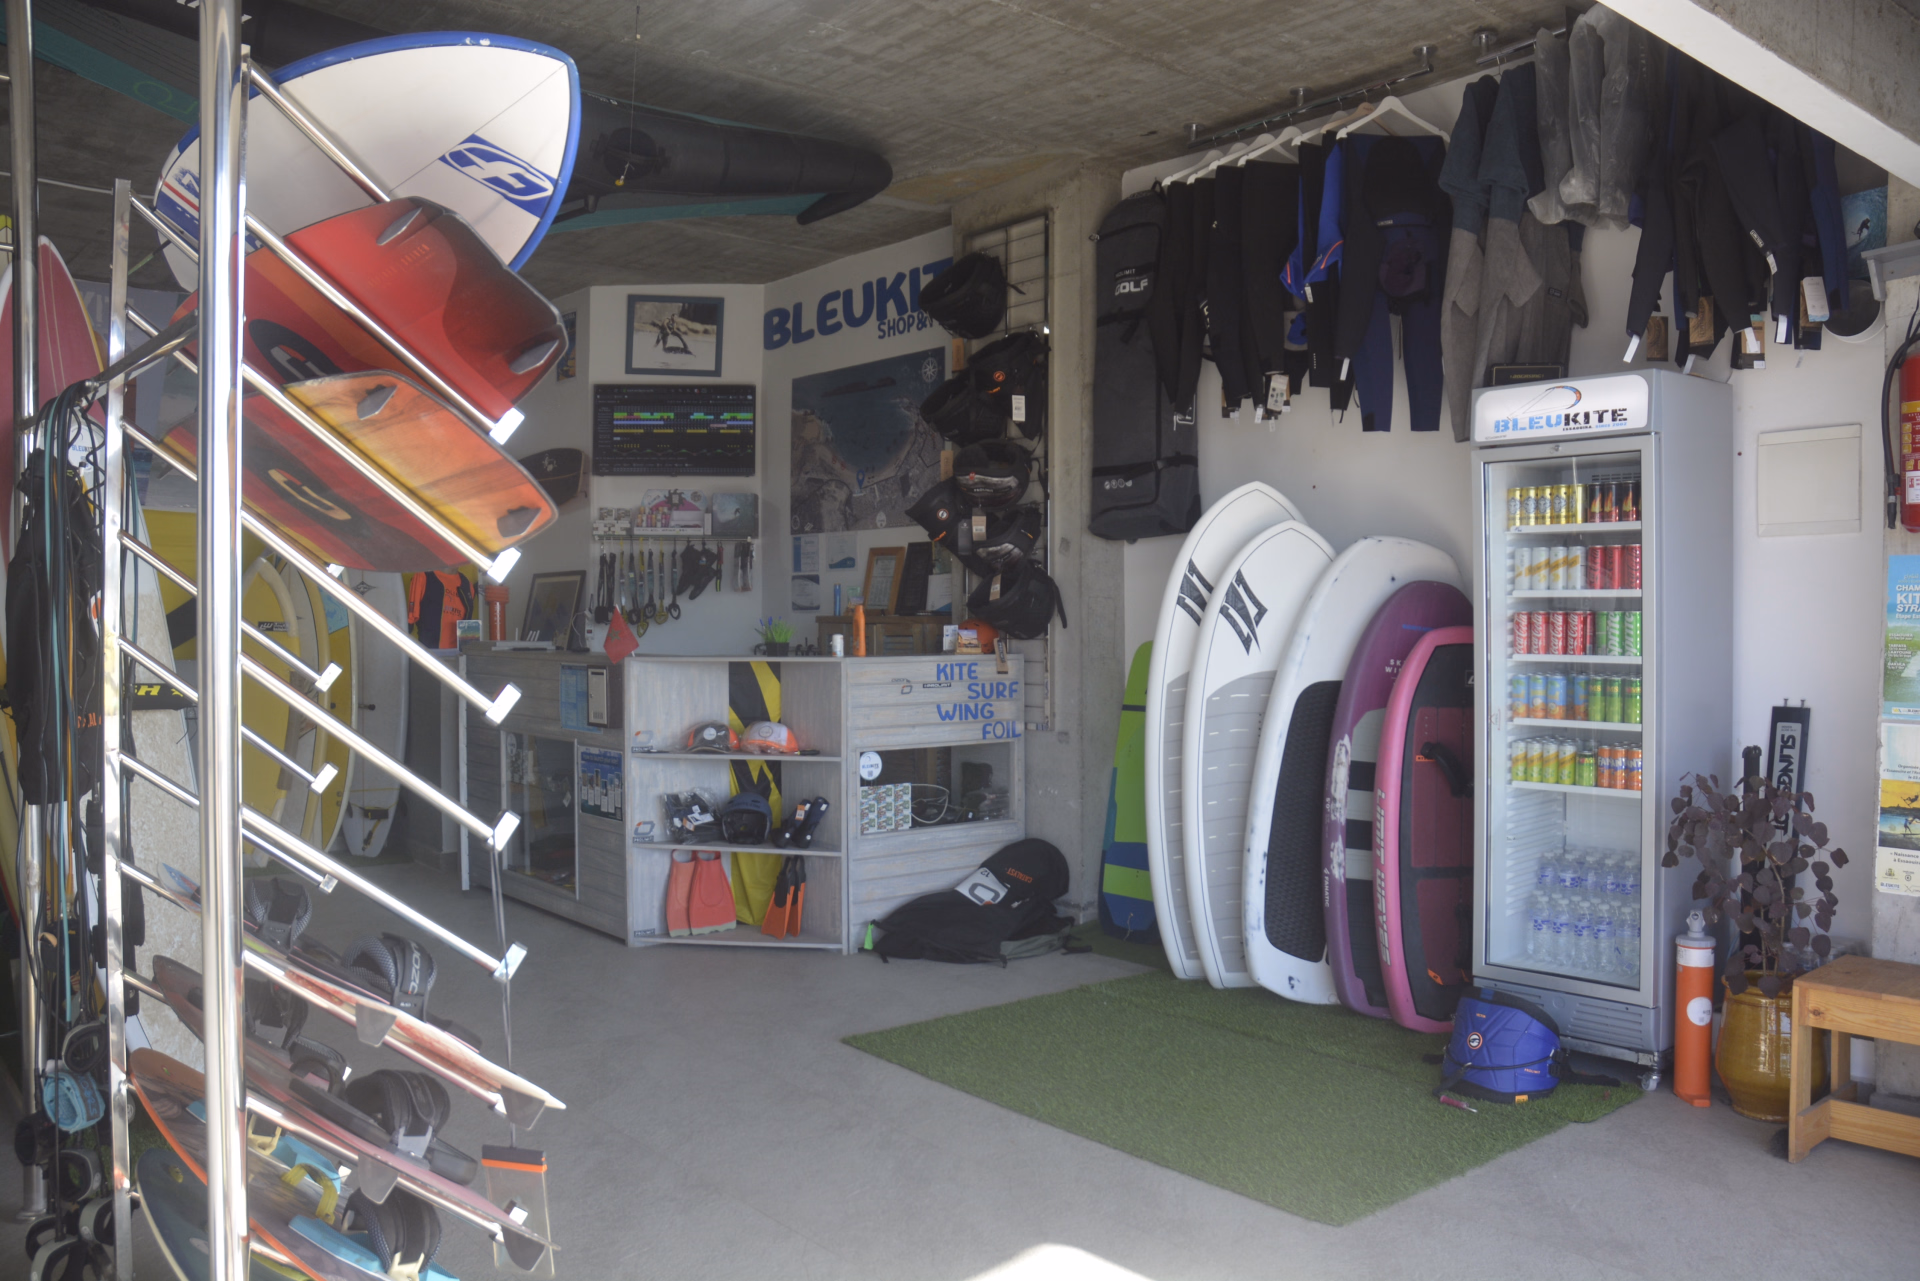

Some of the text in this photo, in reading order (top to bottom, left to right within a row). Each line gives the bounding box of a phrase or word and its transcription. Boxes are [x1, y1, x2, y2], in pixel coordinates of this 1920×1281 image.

[1115, 278, 1149, 296] GOLF
[1493, 407, 1628, 433] BLEUKITE
[1896, 604, 1920, 613] STR
[936, 662, 979, 681] KITE
[1390, 658, 1406, 667] SK
[967, 681, 1019, 700] SURF
[936, 702, 995, 722] WING
[982, 721, 1022, 740] FOIL
